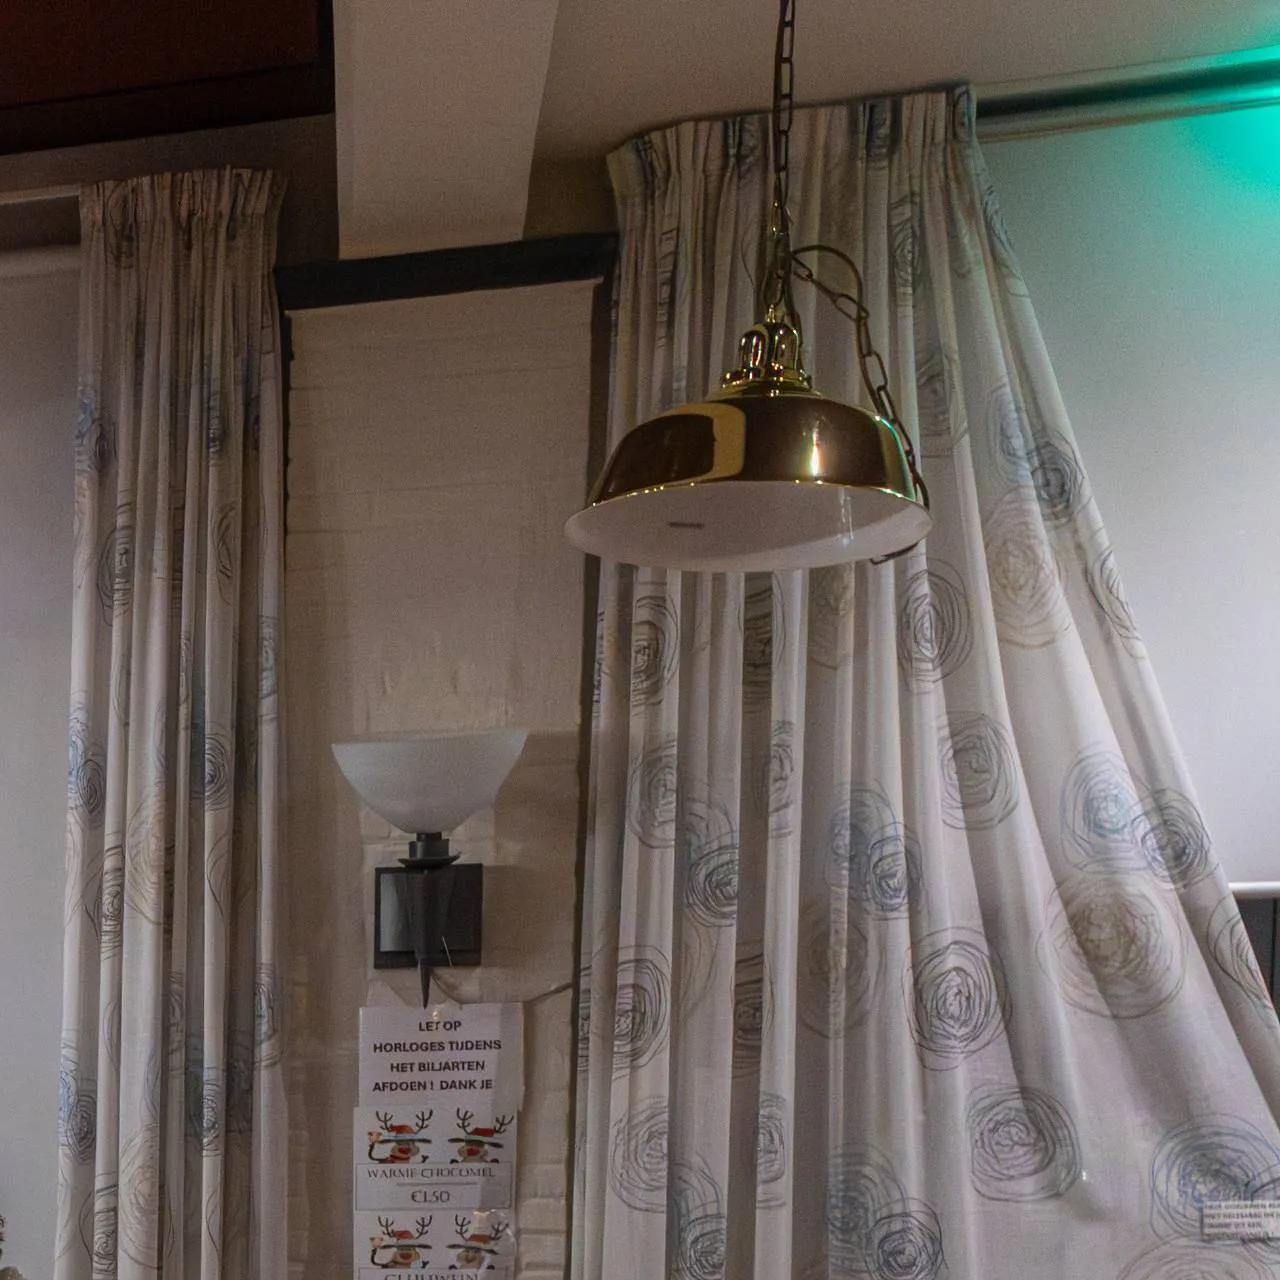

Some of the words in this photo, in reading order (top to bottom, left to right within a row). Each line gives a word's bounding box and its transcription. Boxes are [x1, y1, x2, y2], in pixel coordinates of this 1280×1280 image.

[418, 1020, 440, 1032] LET
[443, 1020, 462, 1031] OP
[373, 1041, 445, 1053] HORLOGES
[448, 1039, 502, 1051] TIJDENS
[390, 1062, 415, 1073] HET
[418, 1060, 485, 1072] BILJARTEN
[372, 1080, 427, 1092] AFDOEN
[440, 1079, 477, 1090] DANK
[479, 1079, 493, 1090] JE
[420, 1167, 496, 1178] CHOCOMEL
